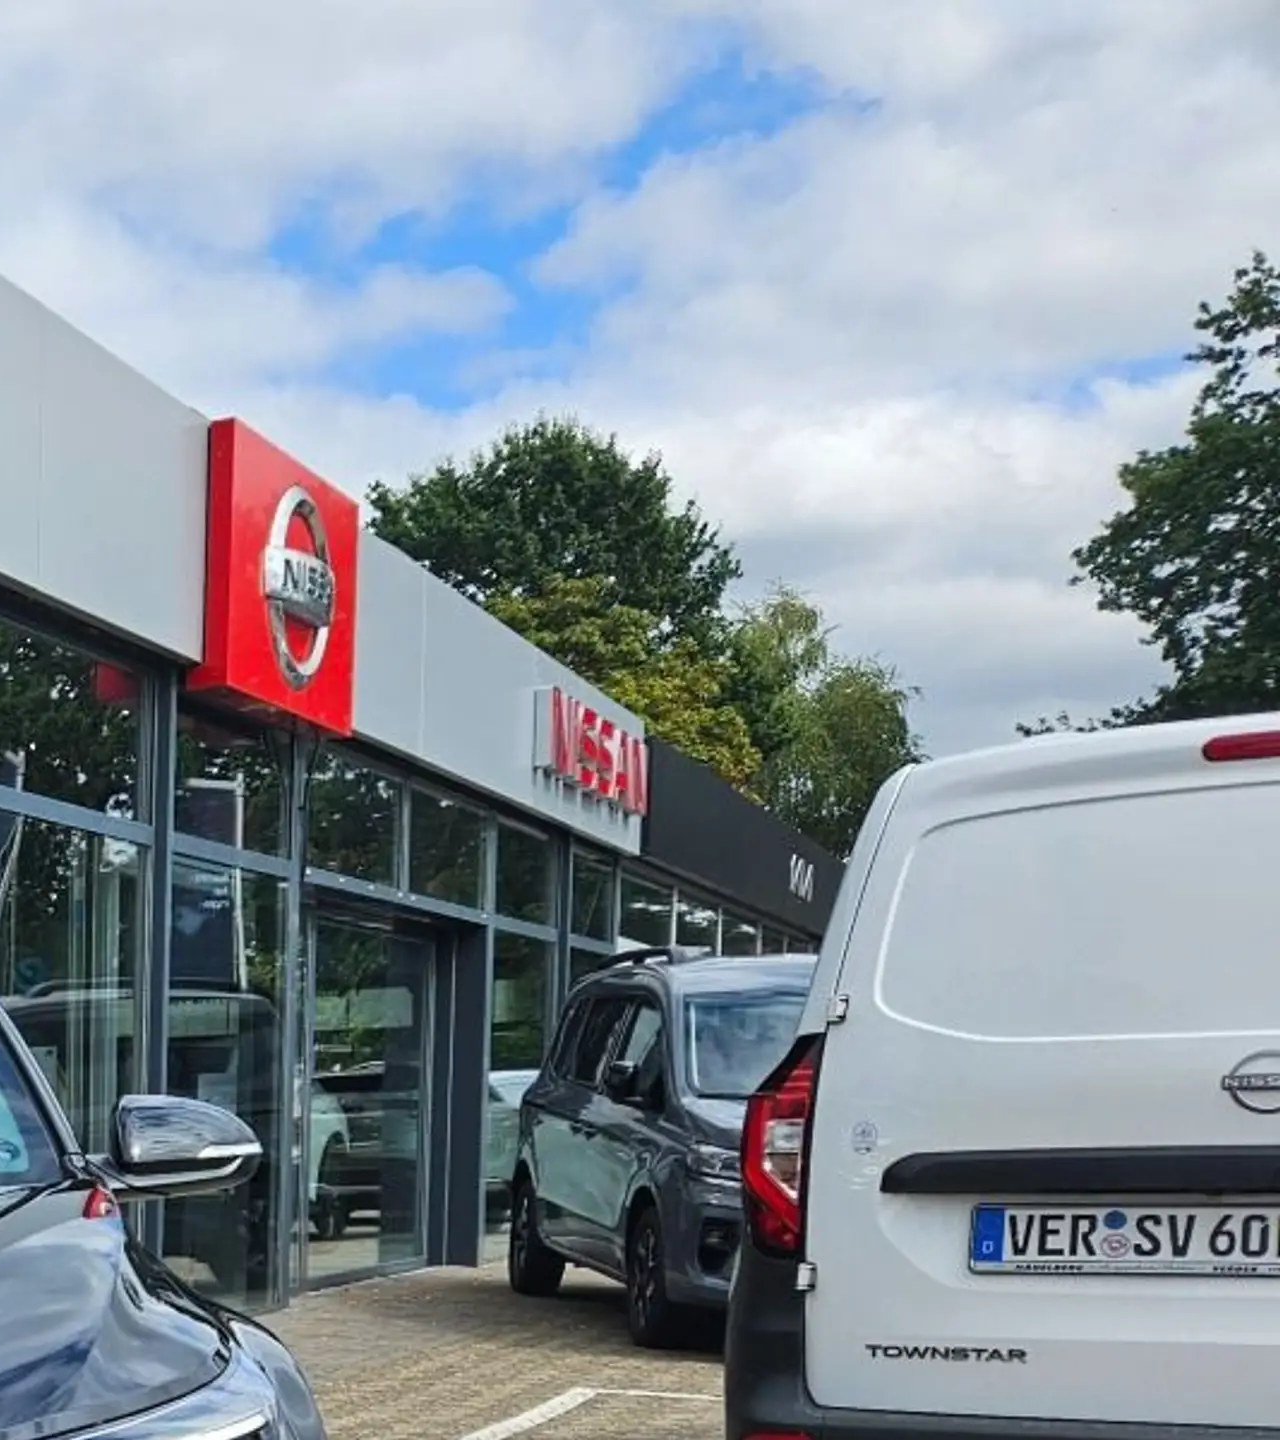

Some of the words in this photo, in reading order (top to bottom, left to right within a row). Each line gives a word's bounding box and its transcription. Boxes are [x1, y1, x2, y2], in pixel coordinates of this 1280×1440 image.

[1009, 1214, 1098, 1257] VER
[1134, 1214, 1197, 1257] SV
[1209, 1214, 1280, 1257] 60
[865, 1344, 1028, 1364] TOWNSTAR
